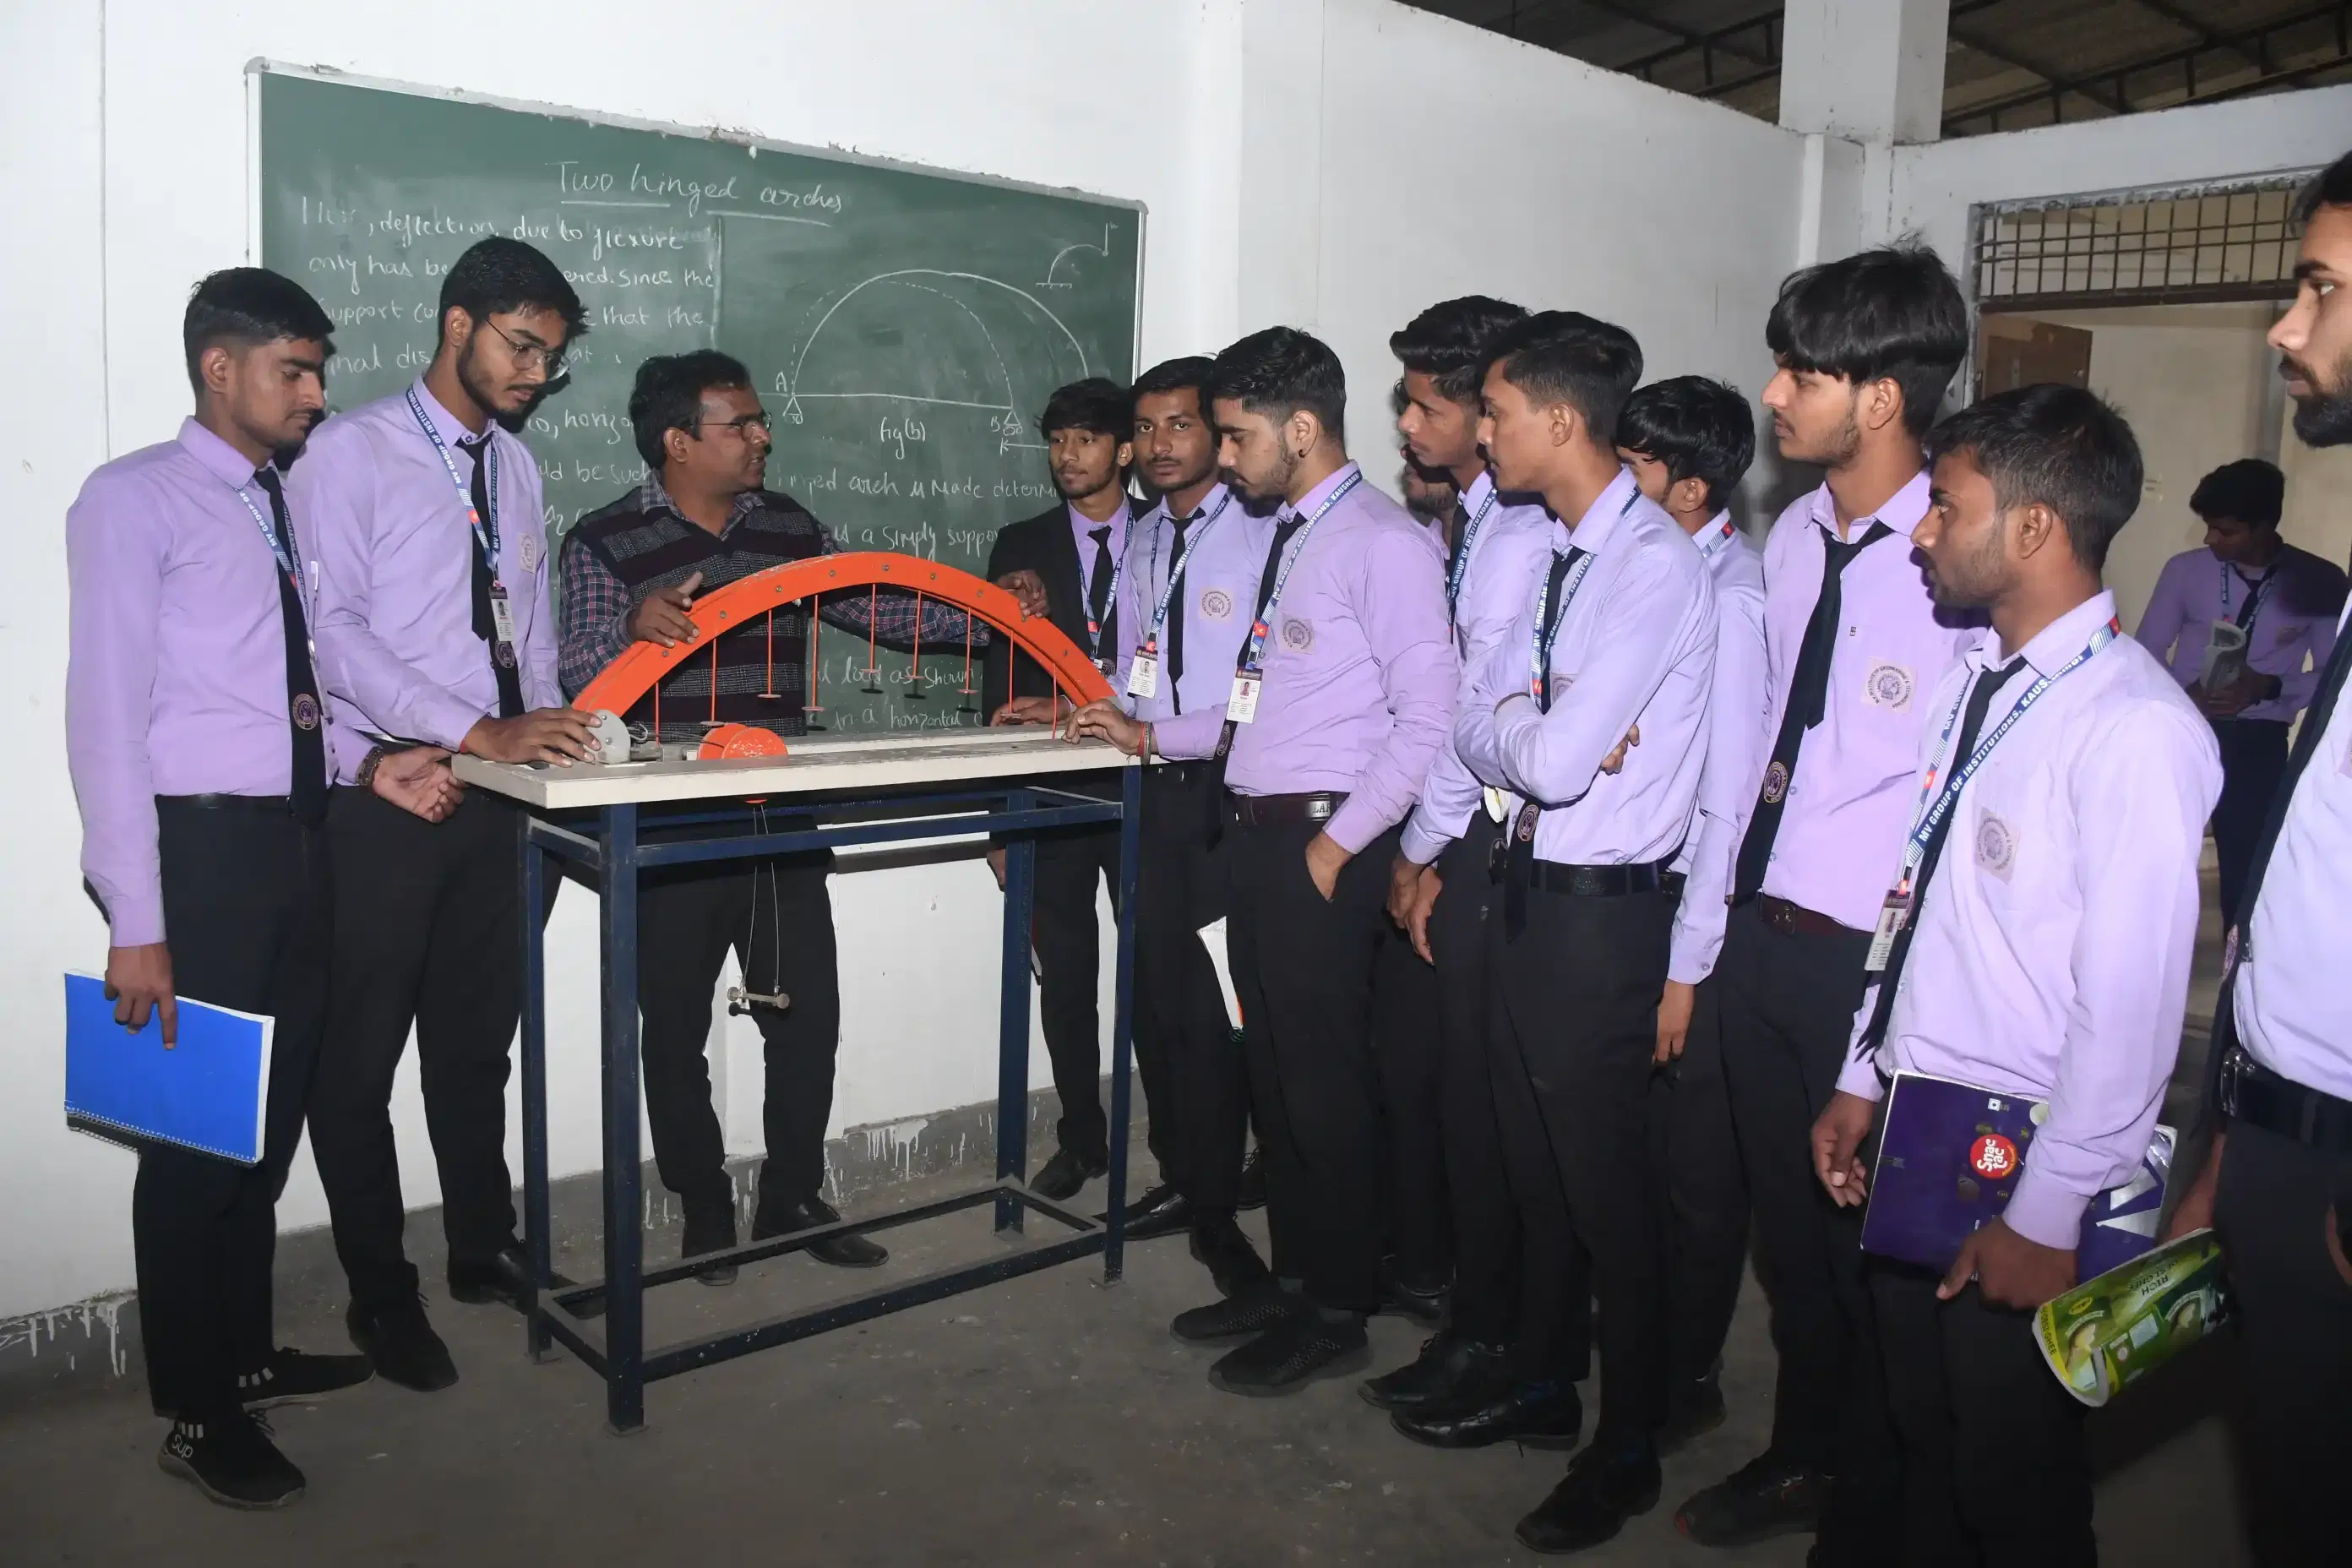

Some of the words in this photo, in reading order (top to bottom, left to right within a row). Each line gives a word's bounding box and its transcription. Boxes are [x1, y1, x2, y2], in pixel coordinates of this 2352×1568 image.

[547, 161, 614, 193] Two
[629, 162, 742, 218] hinged
[513, 215, 551, 241] due
[309, 254, 360, 296] only
[368, 254, 415, 278] has
[684, 267, 715, 288] the
[602, 304, 650, 327] that
[667, 304, 704, 329] the
[775, 372, 788, 394] A
[431, 433, 442, 444] OF
[438, 445, 455, 471] GROUP
[452, 470, 462, 484] MV
[575, 460, 606, 482] be
[848, 471, 900, 497] arch
[248, 504, 269, 532] GROUP
[265, 533, 278, 547] MV
[861, 528, 875, 545] a
[1453, 558, 1466, 585] GROUP
[1461, 547, 1469, 558] OF
[1110, 570, 1119, 591] GROUP
[1108, 591, 1115, 602] MV
[1157, 609, 1163, 620] MV
[1162, 585, 1173, 608] GROUP
[1170, 574, 1177, 585] OF
[1534, 600, 1546, 630] GROUP
[1533, 633, 1541, 648] MV
[1544, 640, 1552, 653] MV
[1943, 712, 1955, 730] MV
[1918, 823, 1932, 842] MV
[1929, 791, 1952, 825] GROUP
[1951, 775, 1964, 792] OF
[1962, 710, 2023, 777] INSTITUTIONS,
[1976, 1138, 1996, 1173] Snac
[1992, 1147, 2008, 1170] tac
[2141, 1274, 2170, 1297] RICH
[2043, 1331, 2058, 1356] GHEE
